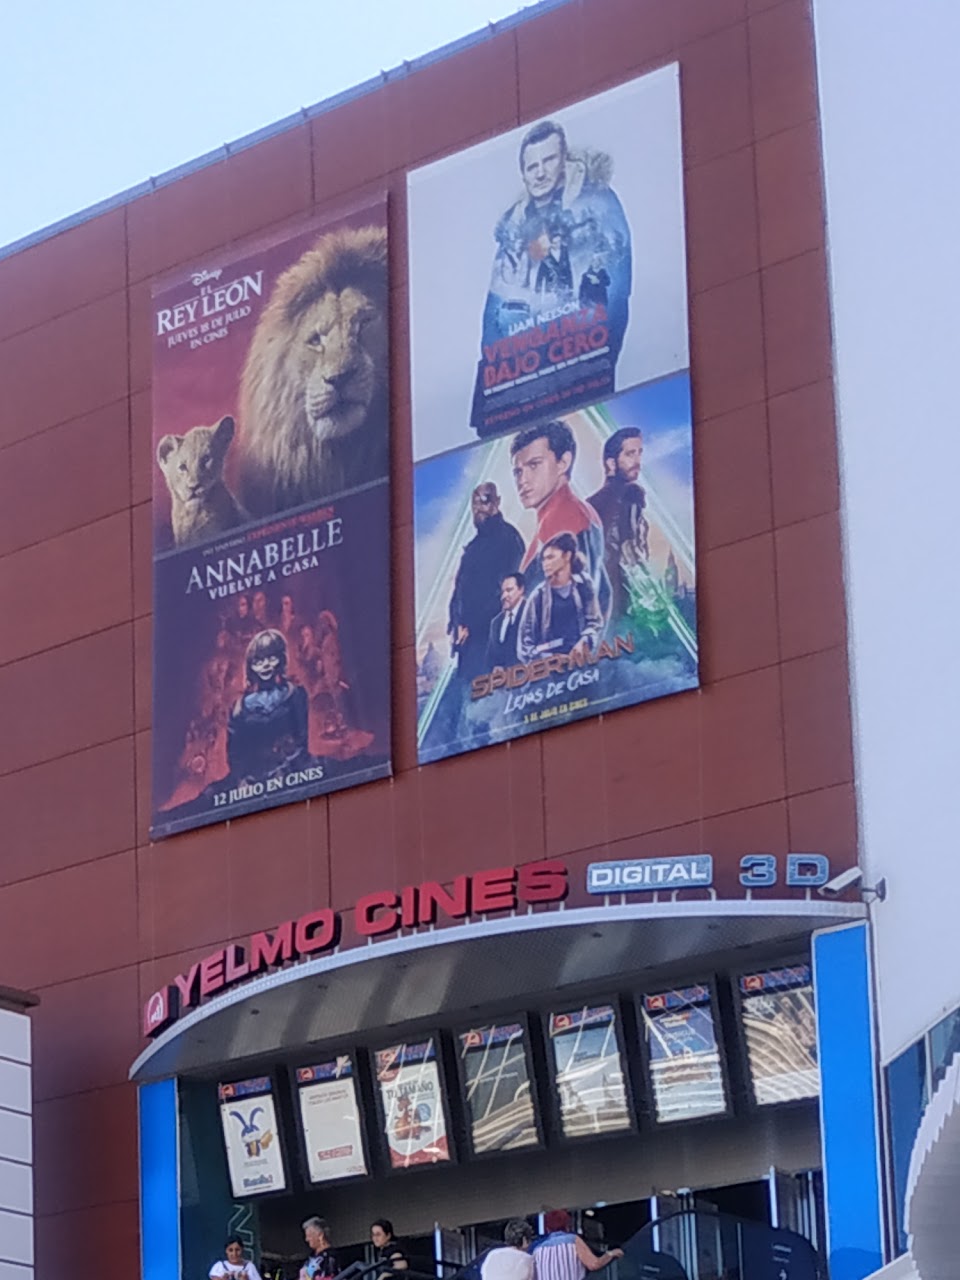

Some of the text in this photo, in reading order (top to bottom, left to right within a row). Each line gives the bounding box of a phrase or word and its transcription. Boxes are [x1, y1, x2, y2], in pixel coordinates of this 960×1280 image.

[190, 269, 223, 286] Disney
[156, 300, 199, 336] REY
[225, 305, 251, 325] JULIO
[483, 303, 608, 363] VENGANZA
[508, 317, 536, 337] LIAM
[483, 350, 541, 388] BAJO
[548, 325, 609, 362] CERO
[185, 518, 344, 594] ANNABELLE
[208, 555, 319, 600] VUELVE A CASA
[471, 632, 635, 702] SPIDER-MAN
[545, 681, 566, 700] DE
[213, 766, 324, 807] 12 JULIO EN CINES
[591, 861, 708, 887] DIGITAL
[174, 860, 568, 1007] YELMO CINES
